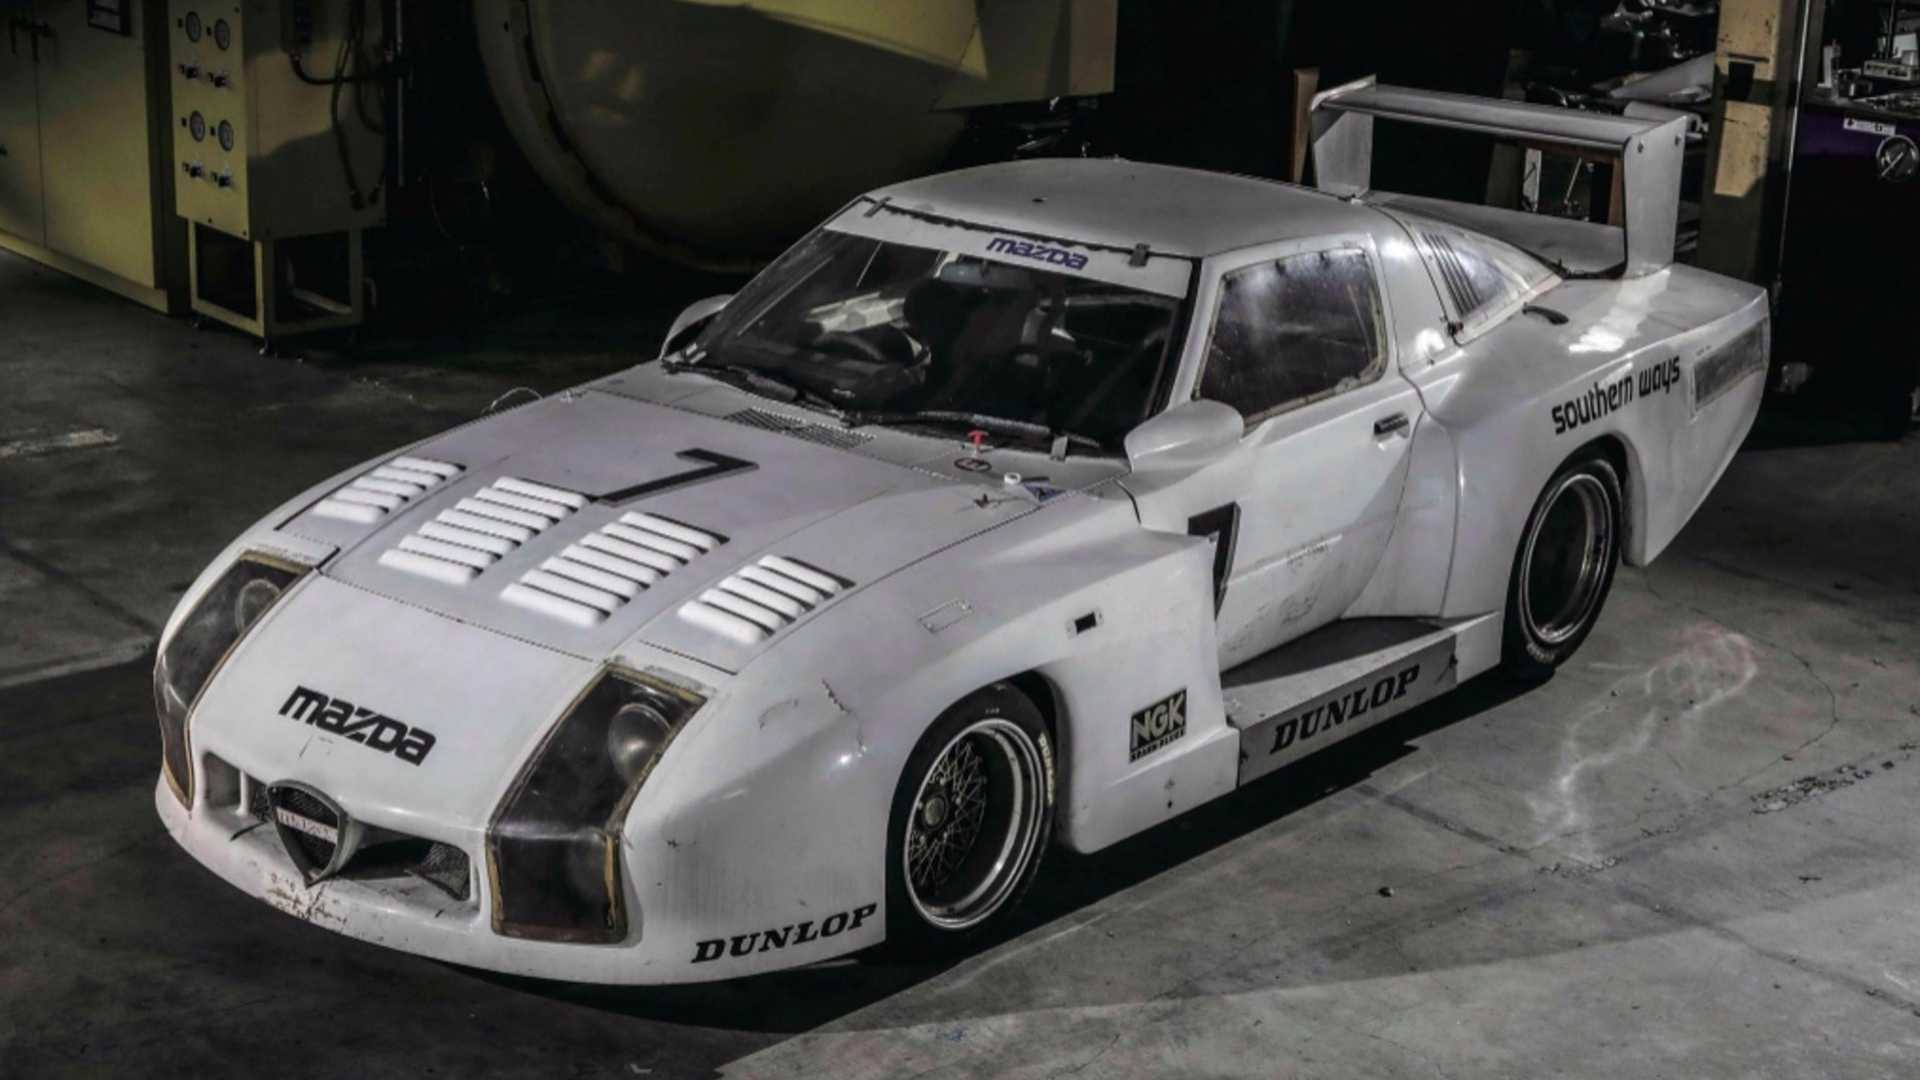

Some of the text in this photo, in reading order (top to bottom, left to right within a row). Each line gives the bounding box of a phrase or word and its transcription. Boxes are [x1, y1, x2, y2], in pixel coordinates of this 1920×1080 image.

[1551, 355, 1680, 435] southern ways
[597, 447, 760, 508] 7
[1187, 500, 1241, 621] 7
[1132, 693, 1184, 750] NGK
[1269, 663, 1420, 755] DUNLOP
[690, 902, 877, 964] DUNLOP
